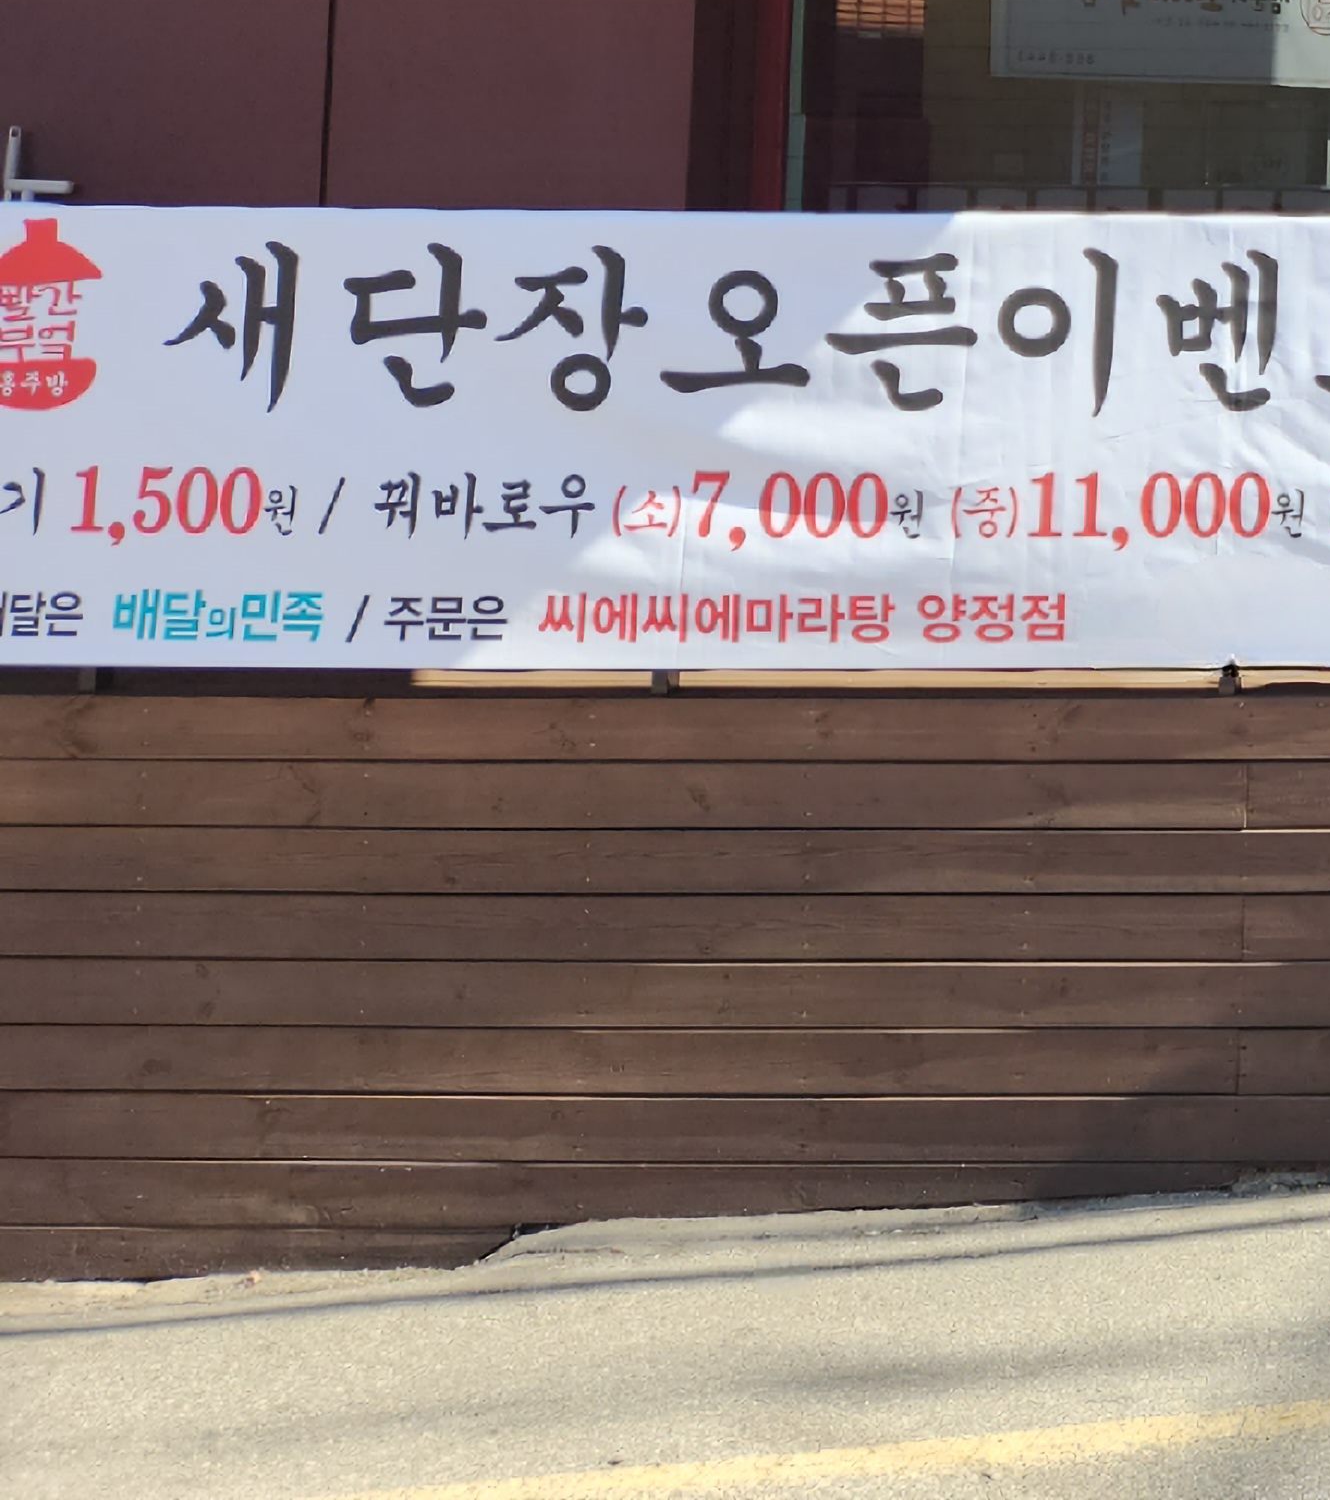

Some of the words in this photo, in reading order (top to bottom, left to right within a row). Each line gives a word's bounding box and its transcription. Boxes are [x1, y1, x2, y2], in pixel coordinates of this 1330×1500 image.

[0, 369, 69, 397] 홍주방
[70, 465, 299, 546] 1,500원
[373, 473, 597, 544] 꿔바로우
[0, 590, 84, 637] 달은
[112, 588, 326, 643] 배달의민족
[382, 595, 509, 642] 주문은
[538, 592, 895, 644] 씨에씨에마라탕
[917, 592, 1068, 645] 양정점
